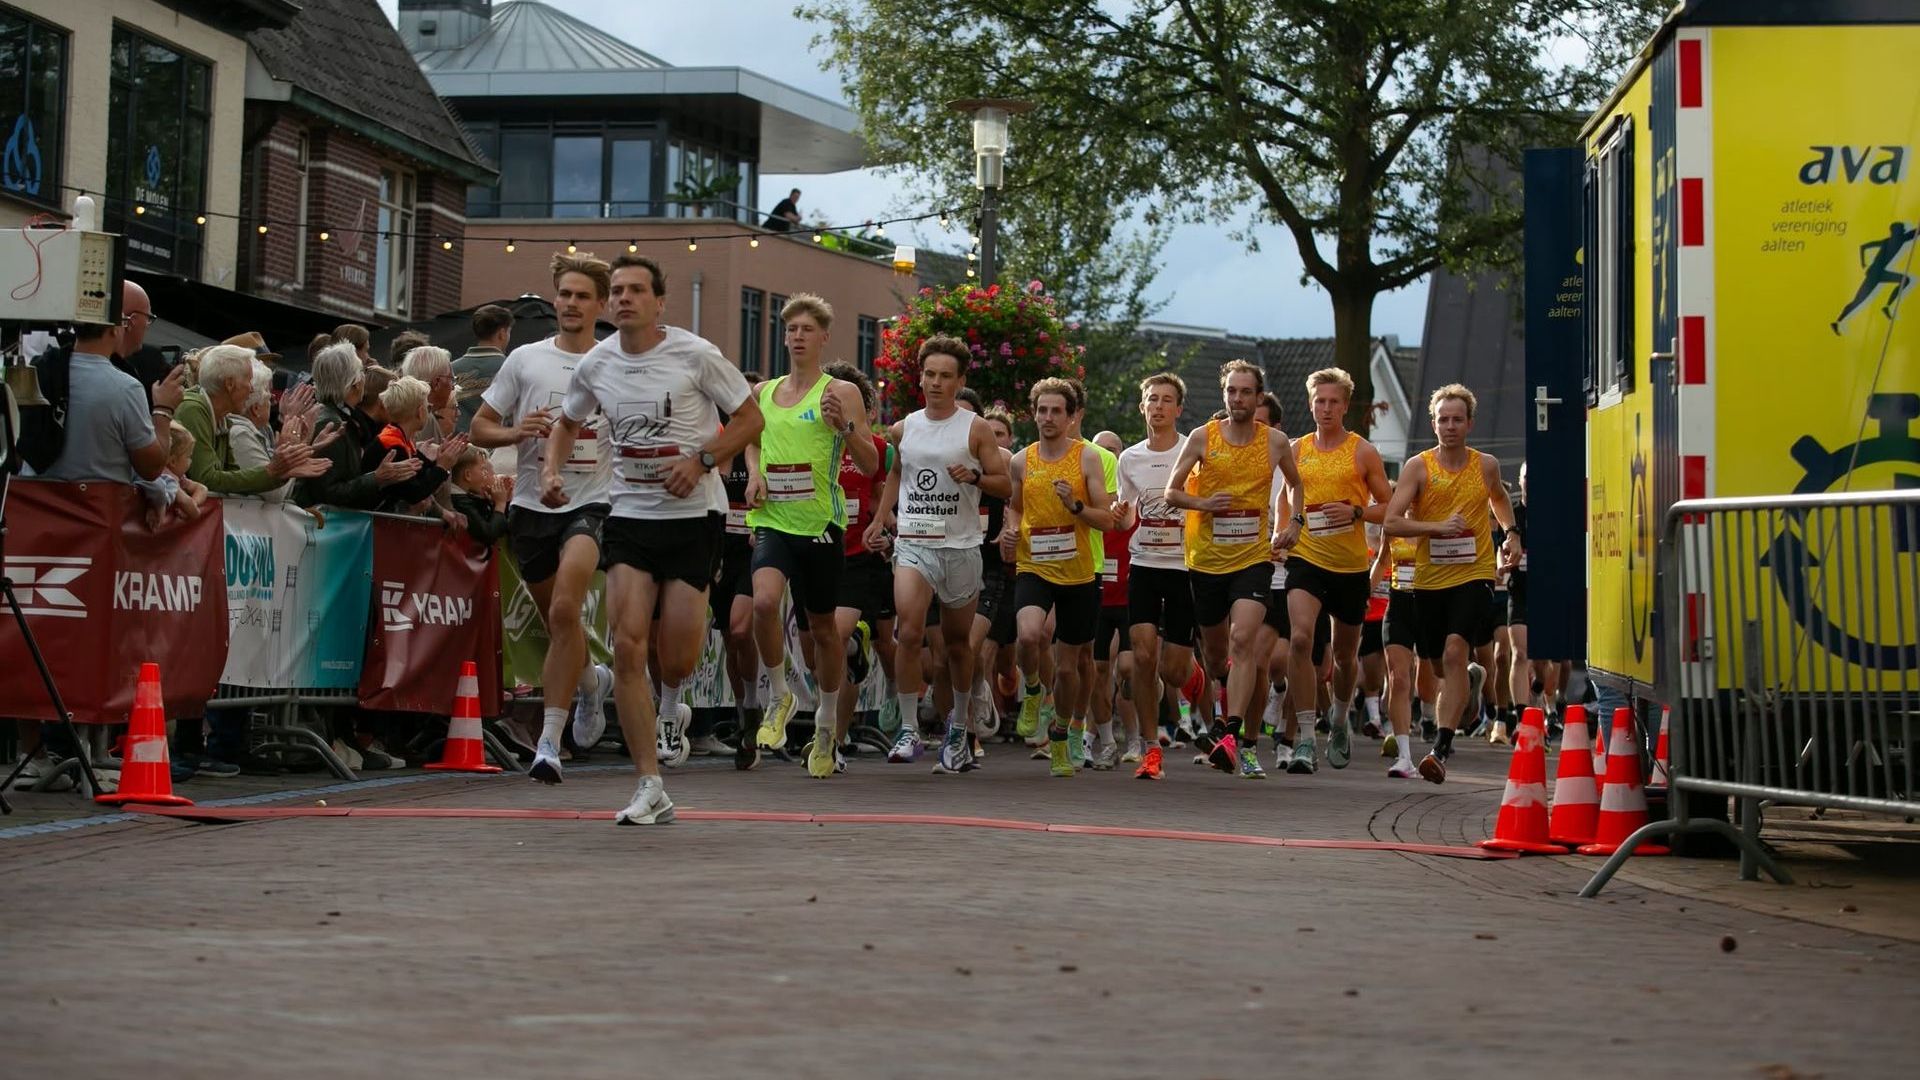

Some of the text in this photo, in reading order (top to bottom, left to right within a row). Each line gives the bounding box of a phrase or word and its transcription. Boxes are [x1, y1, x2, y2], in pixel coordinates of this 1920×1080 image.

[1799, 146, 1904, 185] ava
[1781, 200, 1834, 213] atletiek
[1772, 219, 1848, 237] vereniging
[1760, 239, 1806, 252] aalten
[1562, 275, 1583, 287] atle
[1548, 305, 1581, 317] aalten
[113, 571, 202, 612] KRAMP
